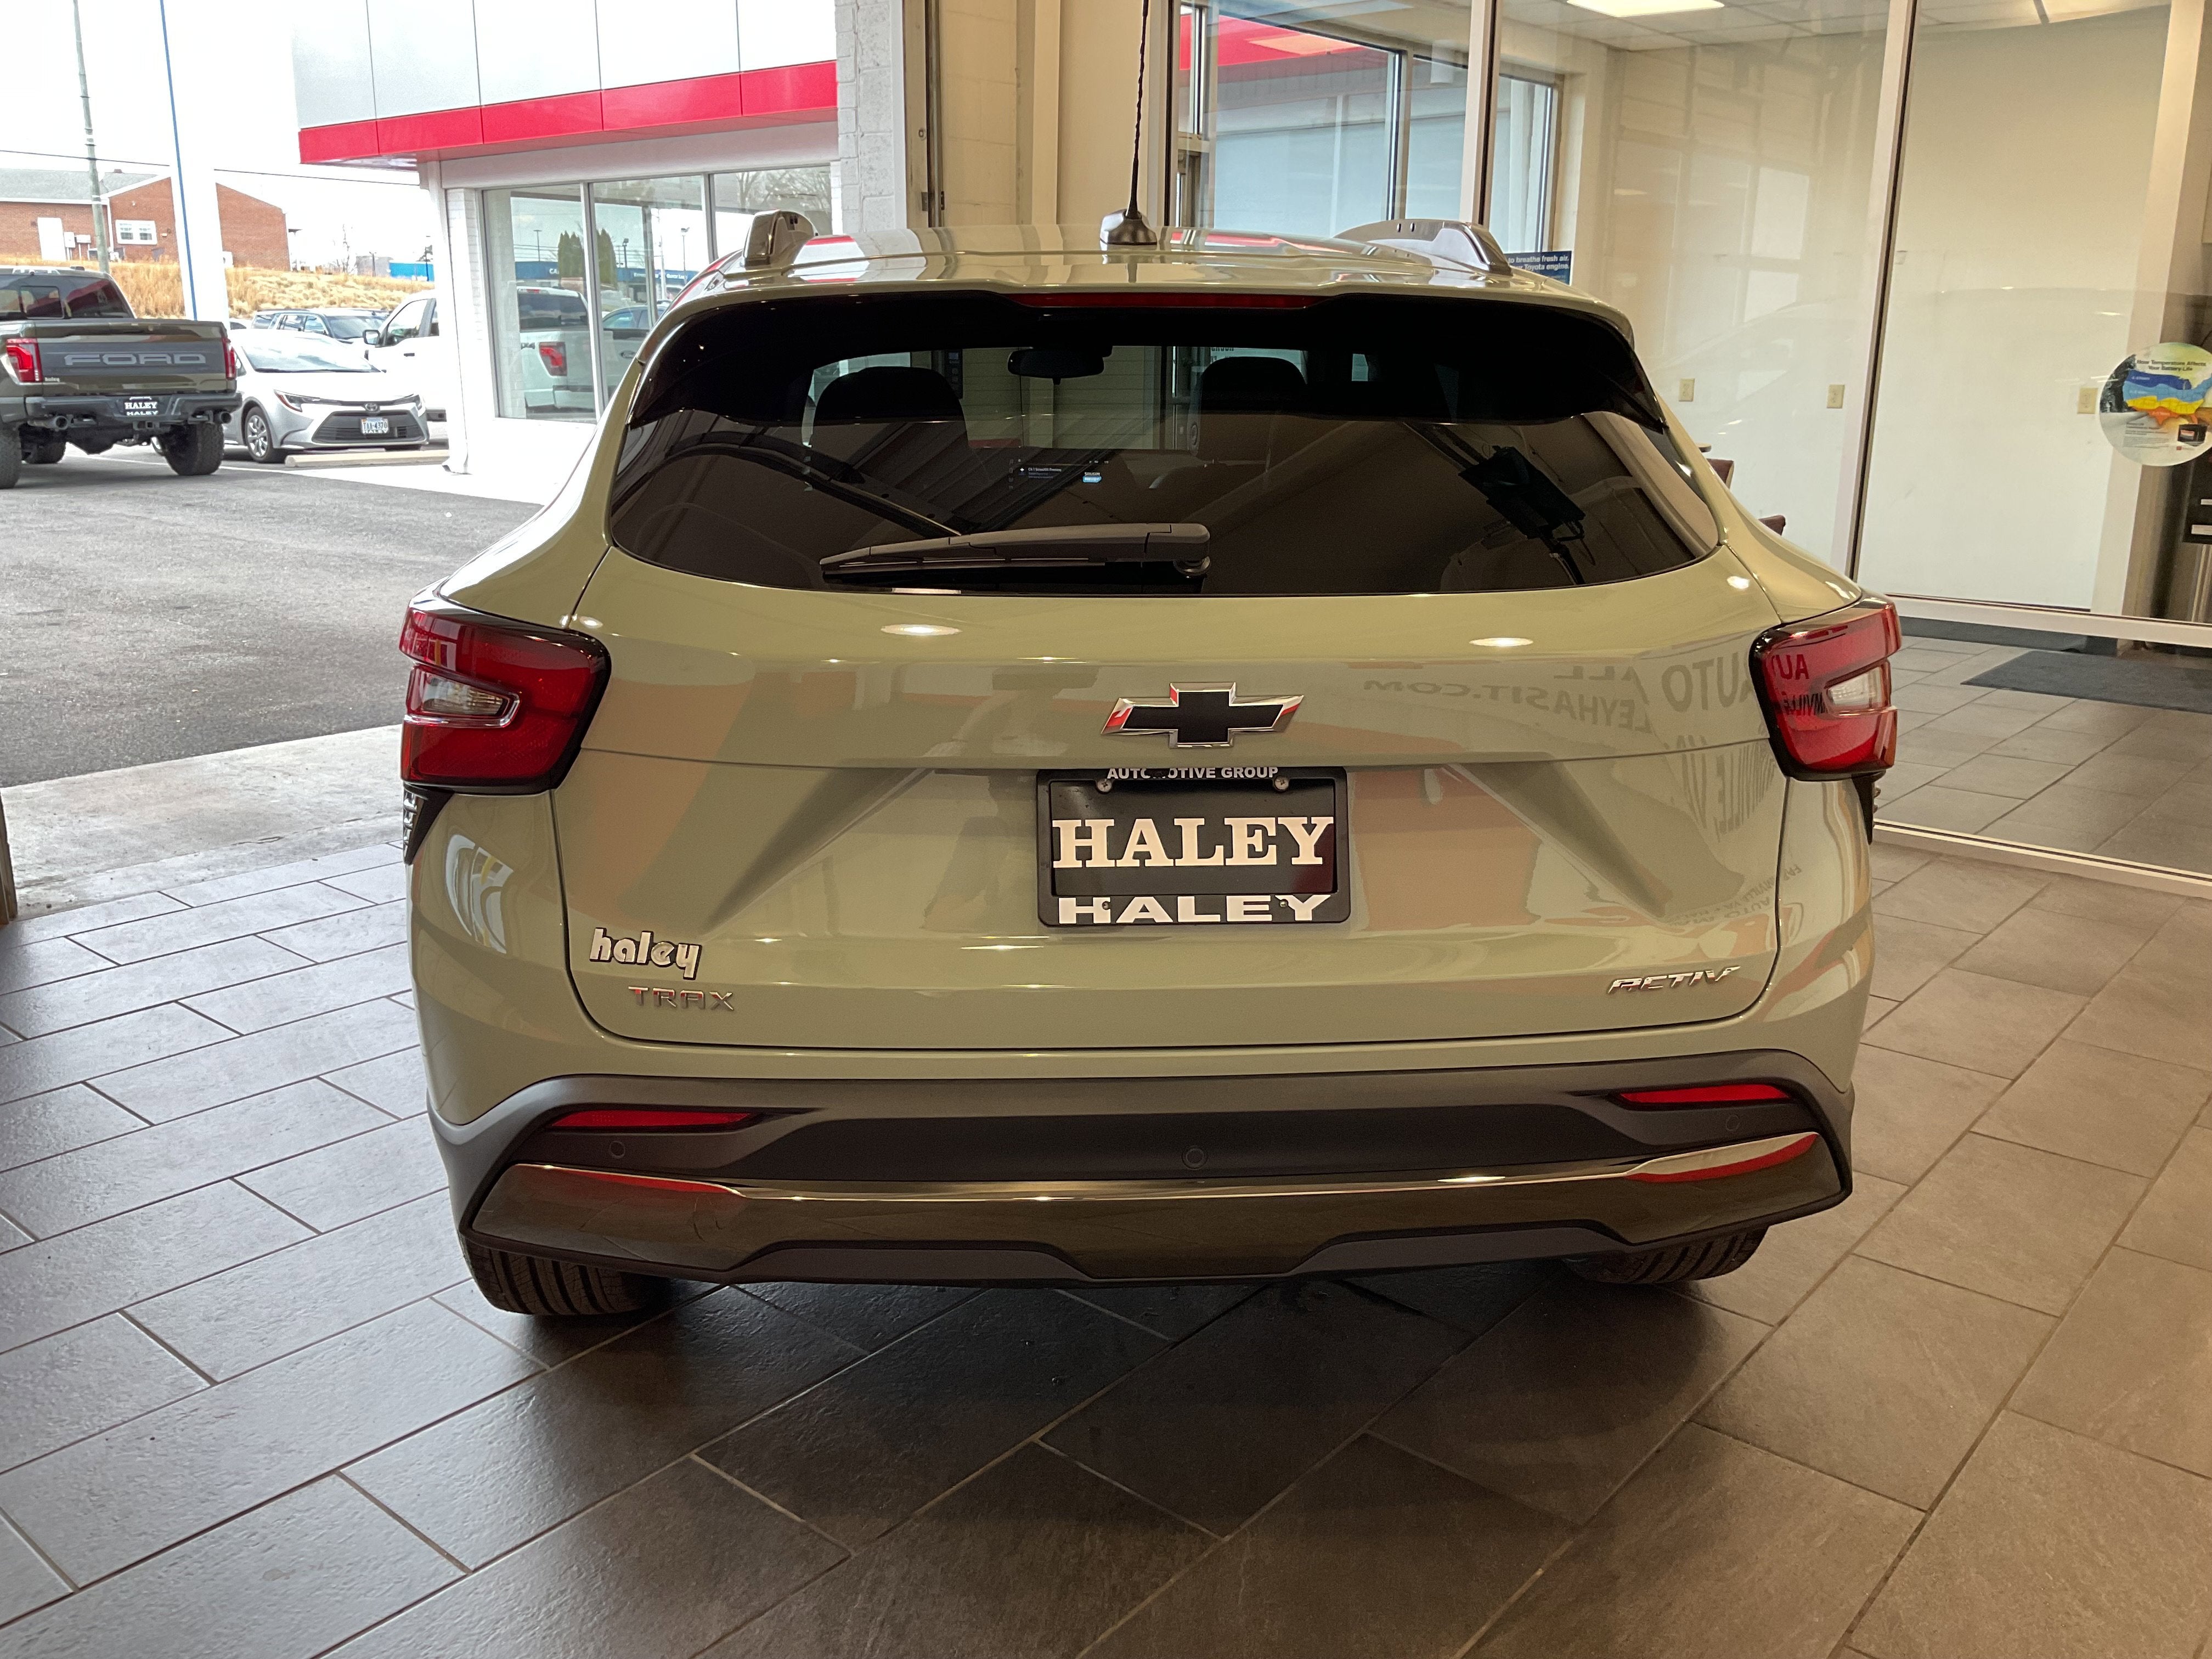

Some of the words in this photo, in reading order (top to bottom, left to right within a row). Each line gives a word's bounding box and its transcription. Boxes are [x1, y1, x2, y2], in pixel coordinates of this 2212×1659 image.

[64, 353, 206, 365] FORD
[1221, 766, 1278, 778] GROUP
[1052, 816, 1334, 868] HALEY
[1058, 894, 1331, 924] HALEY
[589, 927, 702, 980] haley
[1607, 966, 1742, 994] ACTIV
[628, 986, 734, 1011] TRAX
